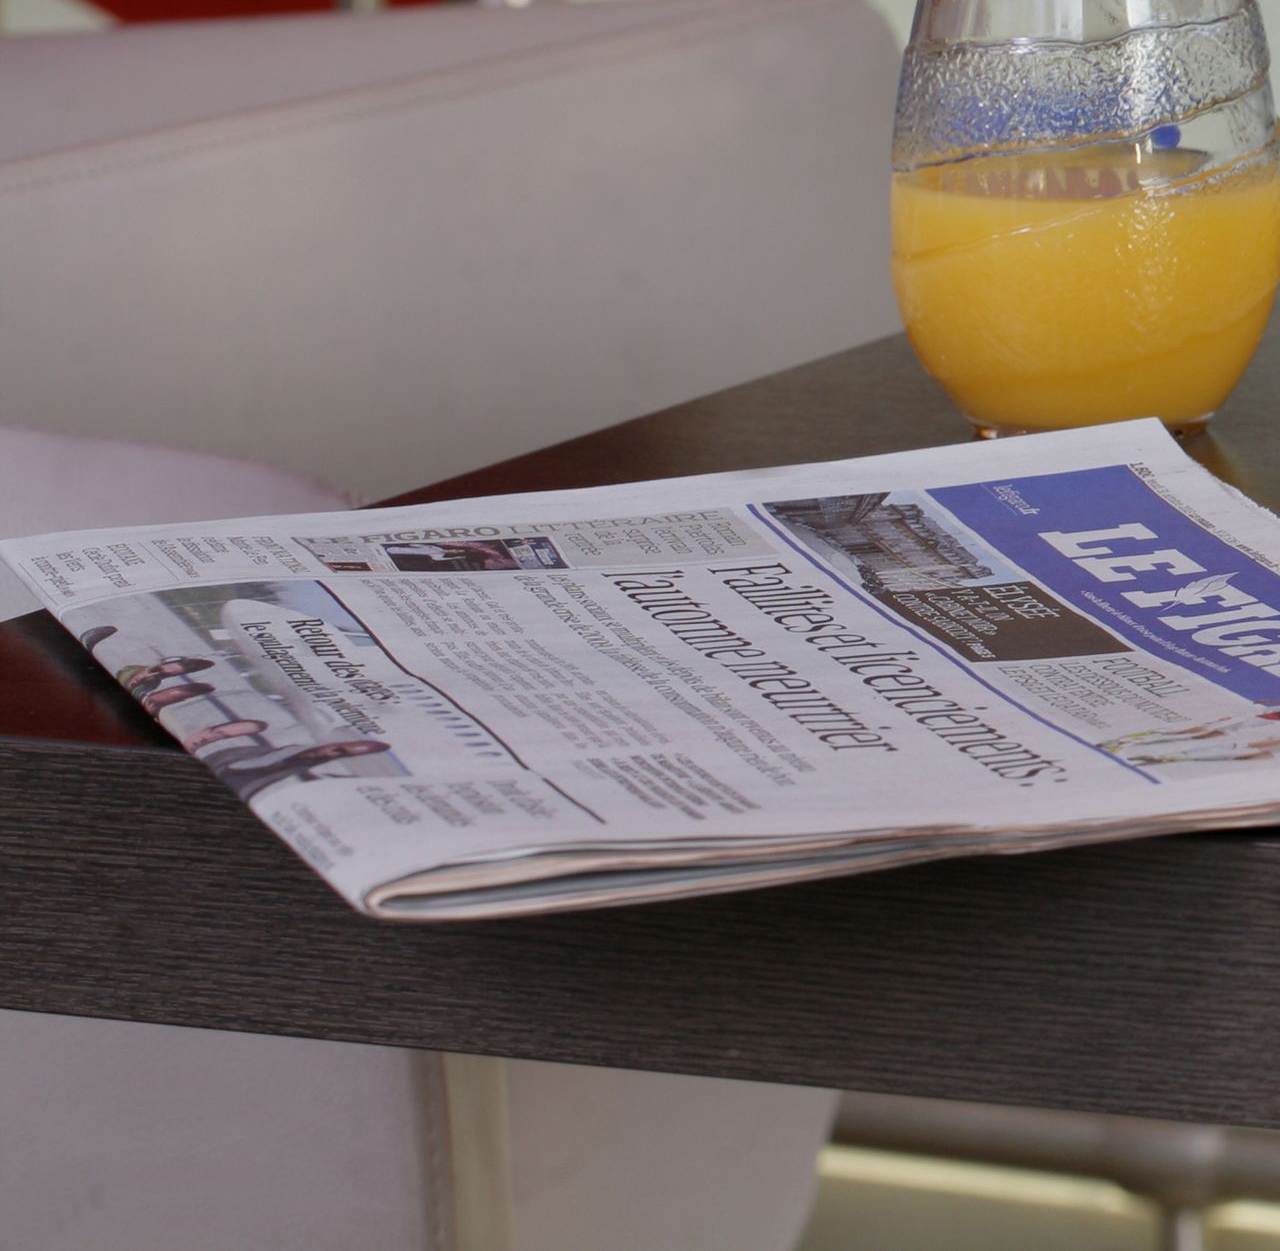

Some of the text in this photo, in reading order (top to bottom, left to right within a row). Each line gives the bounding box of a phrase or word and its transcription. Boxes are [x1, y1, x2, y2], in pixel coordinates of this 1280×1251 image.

[992, 483, 1040, 515] lefigaro.fr
[305, 536, 353, 544] LE
[359, 525, 499, 543] FIGARO
[614, 527, 662, 554] surprise
[1037, 522, 1208, 582] LE
[982, 584, 1059, 619] ÉLYSÉE
[239, 620, 271, 632] le
[249, 632, 319, 687] soulagement
[287, 618, 344, 659] Retour
[323, 660, 365, 679] des
[601, 569, 765, 659] l'automne
[721, 660, 900, 752] meurtrier
[707, 562, 1064, 779] Faillites et licenciements
[1092, 656, 1189, 698] FOOTBALL
